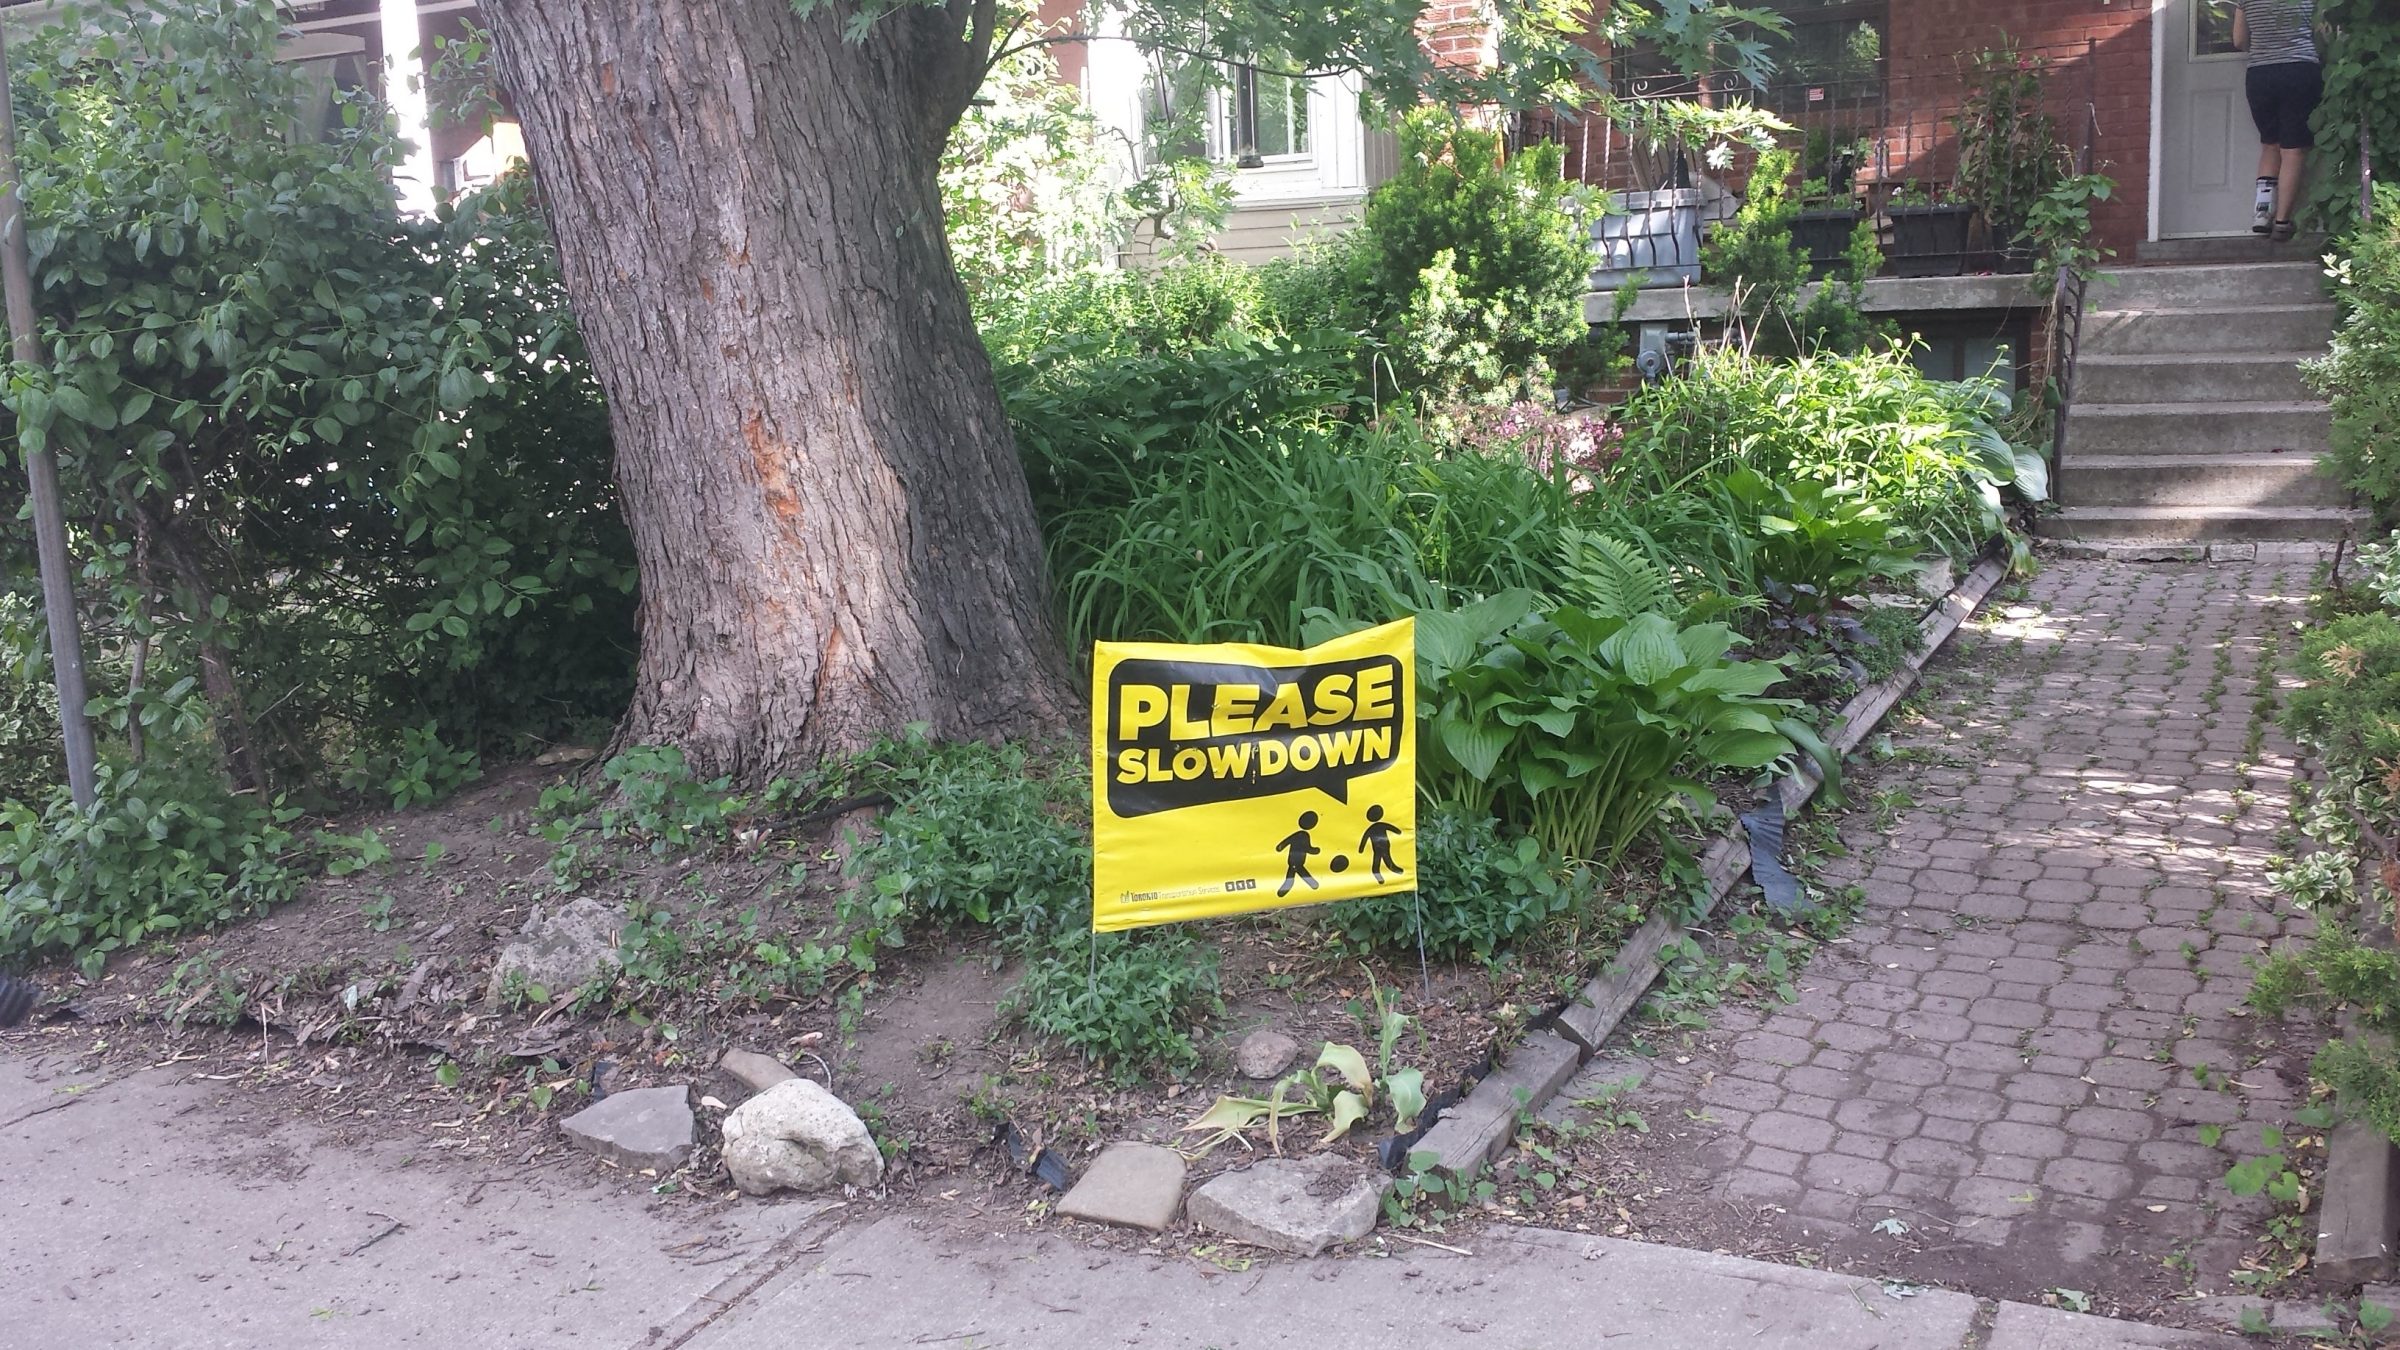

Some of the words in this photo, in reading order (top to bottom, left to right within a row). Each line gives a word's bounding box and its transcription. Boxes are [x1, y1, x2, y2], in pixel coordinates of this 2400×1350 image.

[1119, 664, 1394, 741] PLEASE
[1116, 742, 1251, 784] SLOW
[1259, 726, 1392, 776] DOWN
